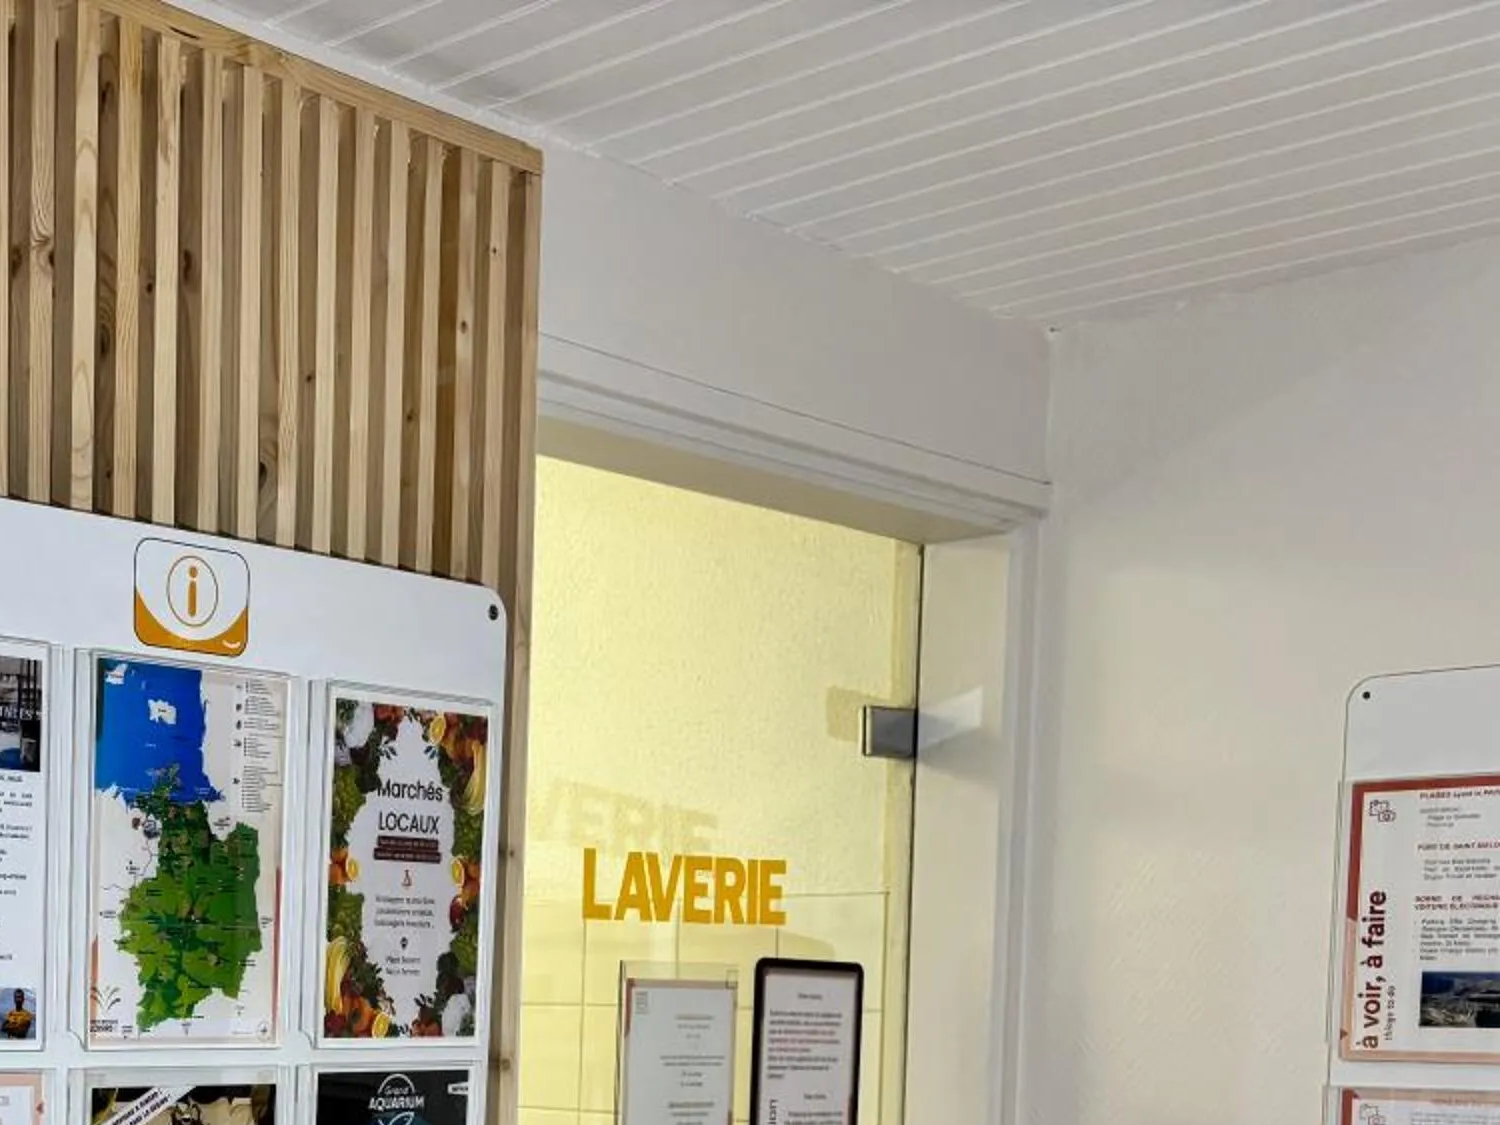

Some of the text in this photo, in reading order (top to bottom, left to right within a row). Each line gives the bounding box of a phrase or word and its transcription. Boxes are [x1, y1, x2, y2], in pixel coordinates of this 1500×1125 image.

[377, 778, 444, 802] Marchés
[378, 811, 441, 834] LOCAUX
[582, 847, 787, 925] LAVERIE
[1355, 891, 1387, 1049] à voir, à faire
[368, 1096, 425, 1112] AQUARIUM
